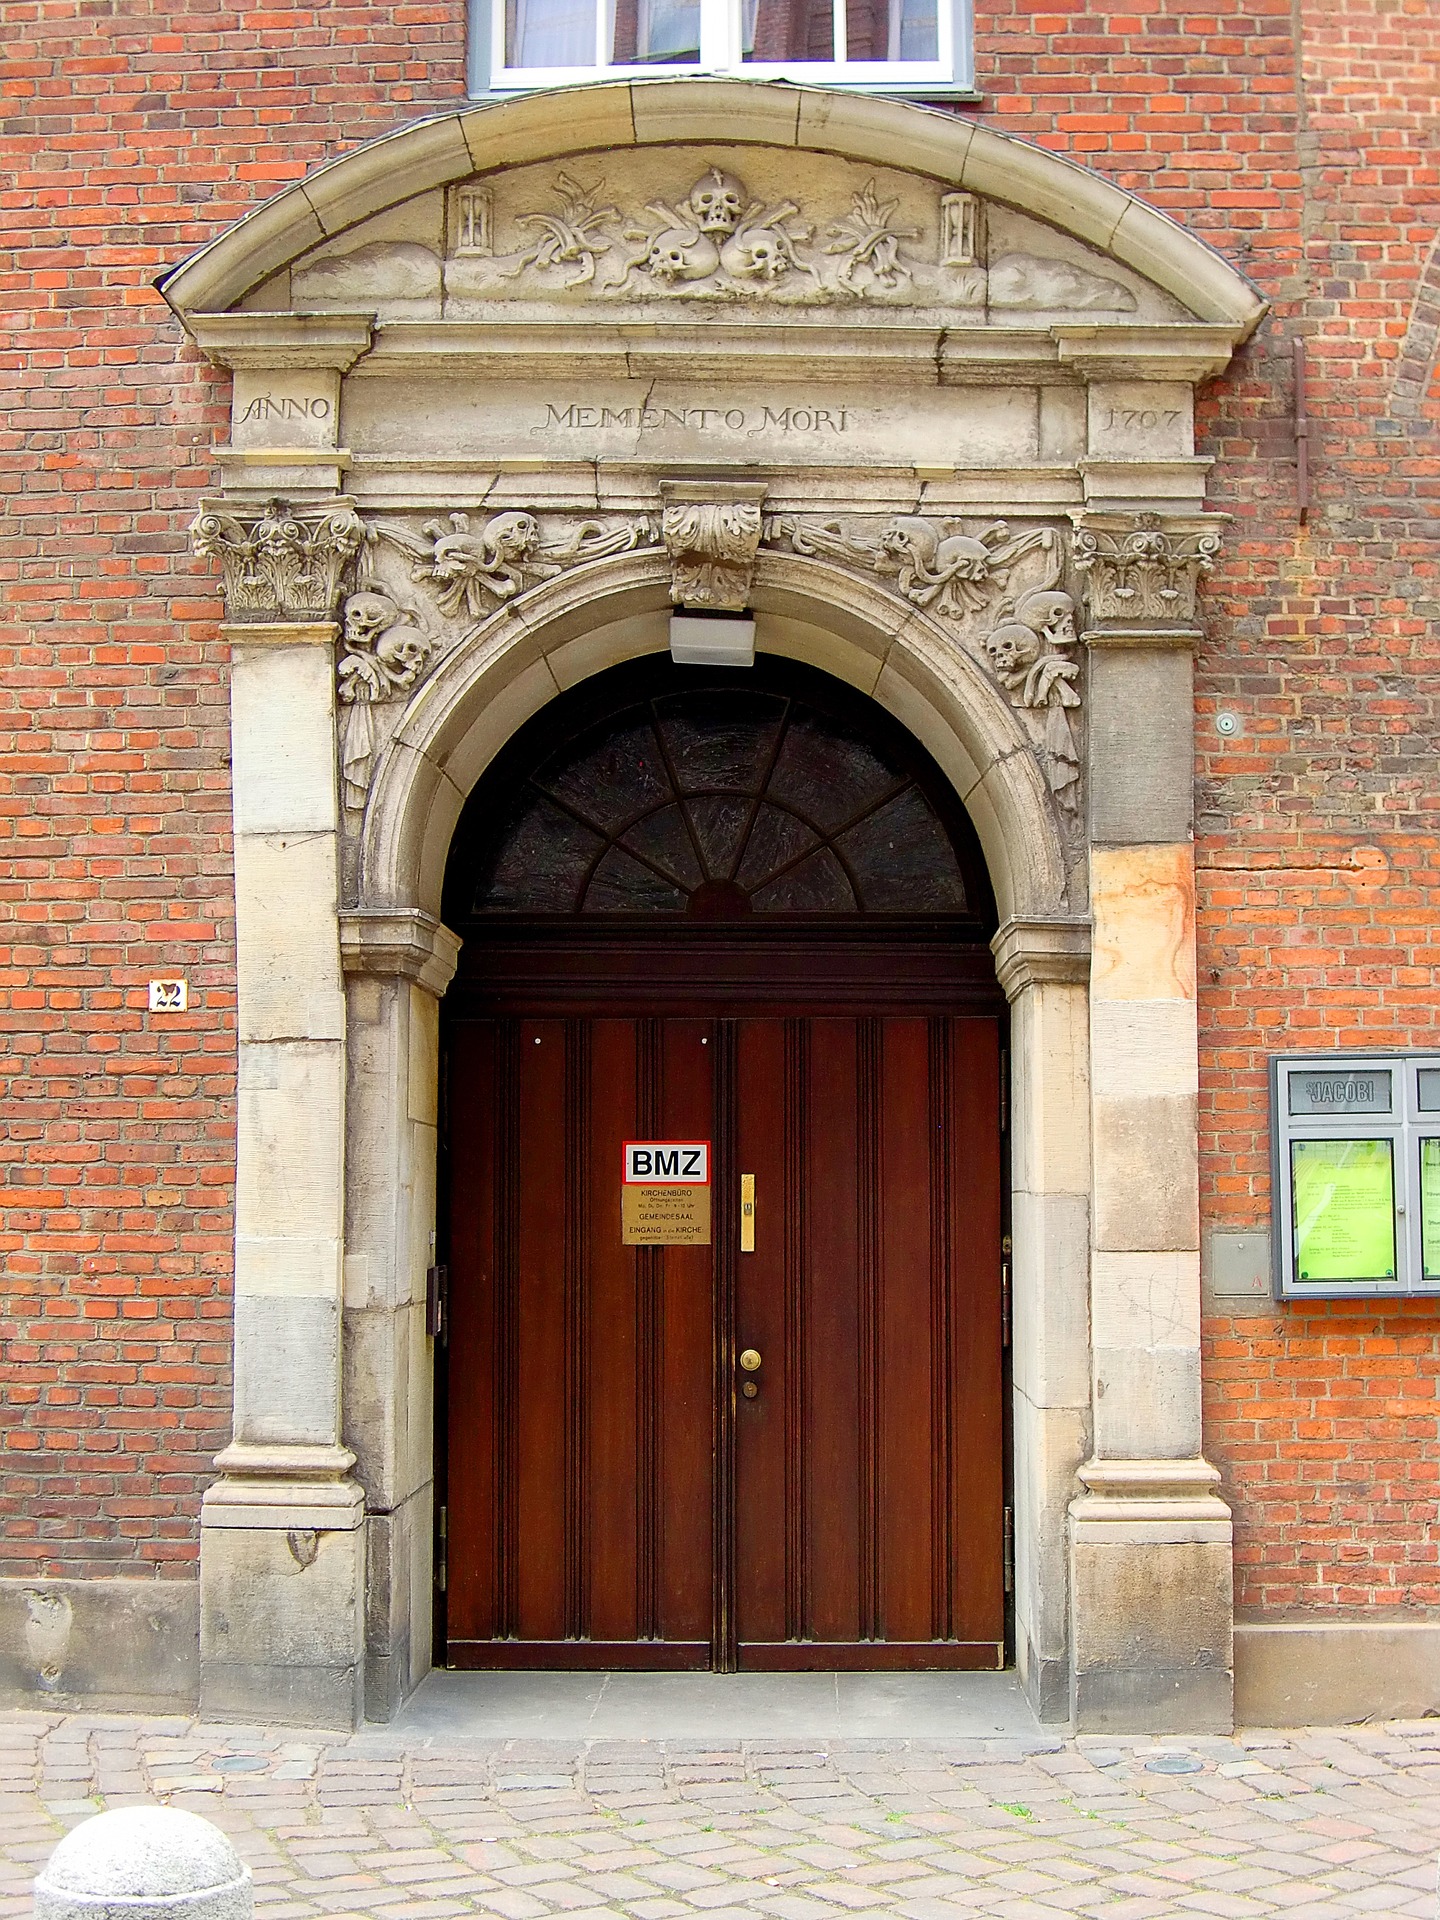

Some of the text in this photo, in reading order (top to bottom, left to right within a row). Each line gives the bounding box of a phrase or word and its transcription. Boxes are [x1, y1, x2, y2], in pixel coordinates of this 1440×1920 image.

[233, 392, 331, 425] ANNO
[530, 403, 849, 438] MEMENTO MORI
[1102, 408, 1183, 432] 1707
[156, 985, 181, 1007] 22
[632, 1150, 701, 1176] BMZ
